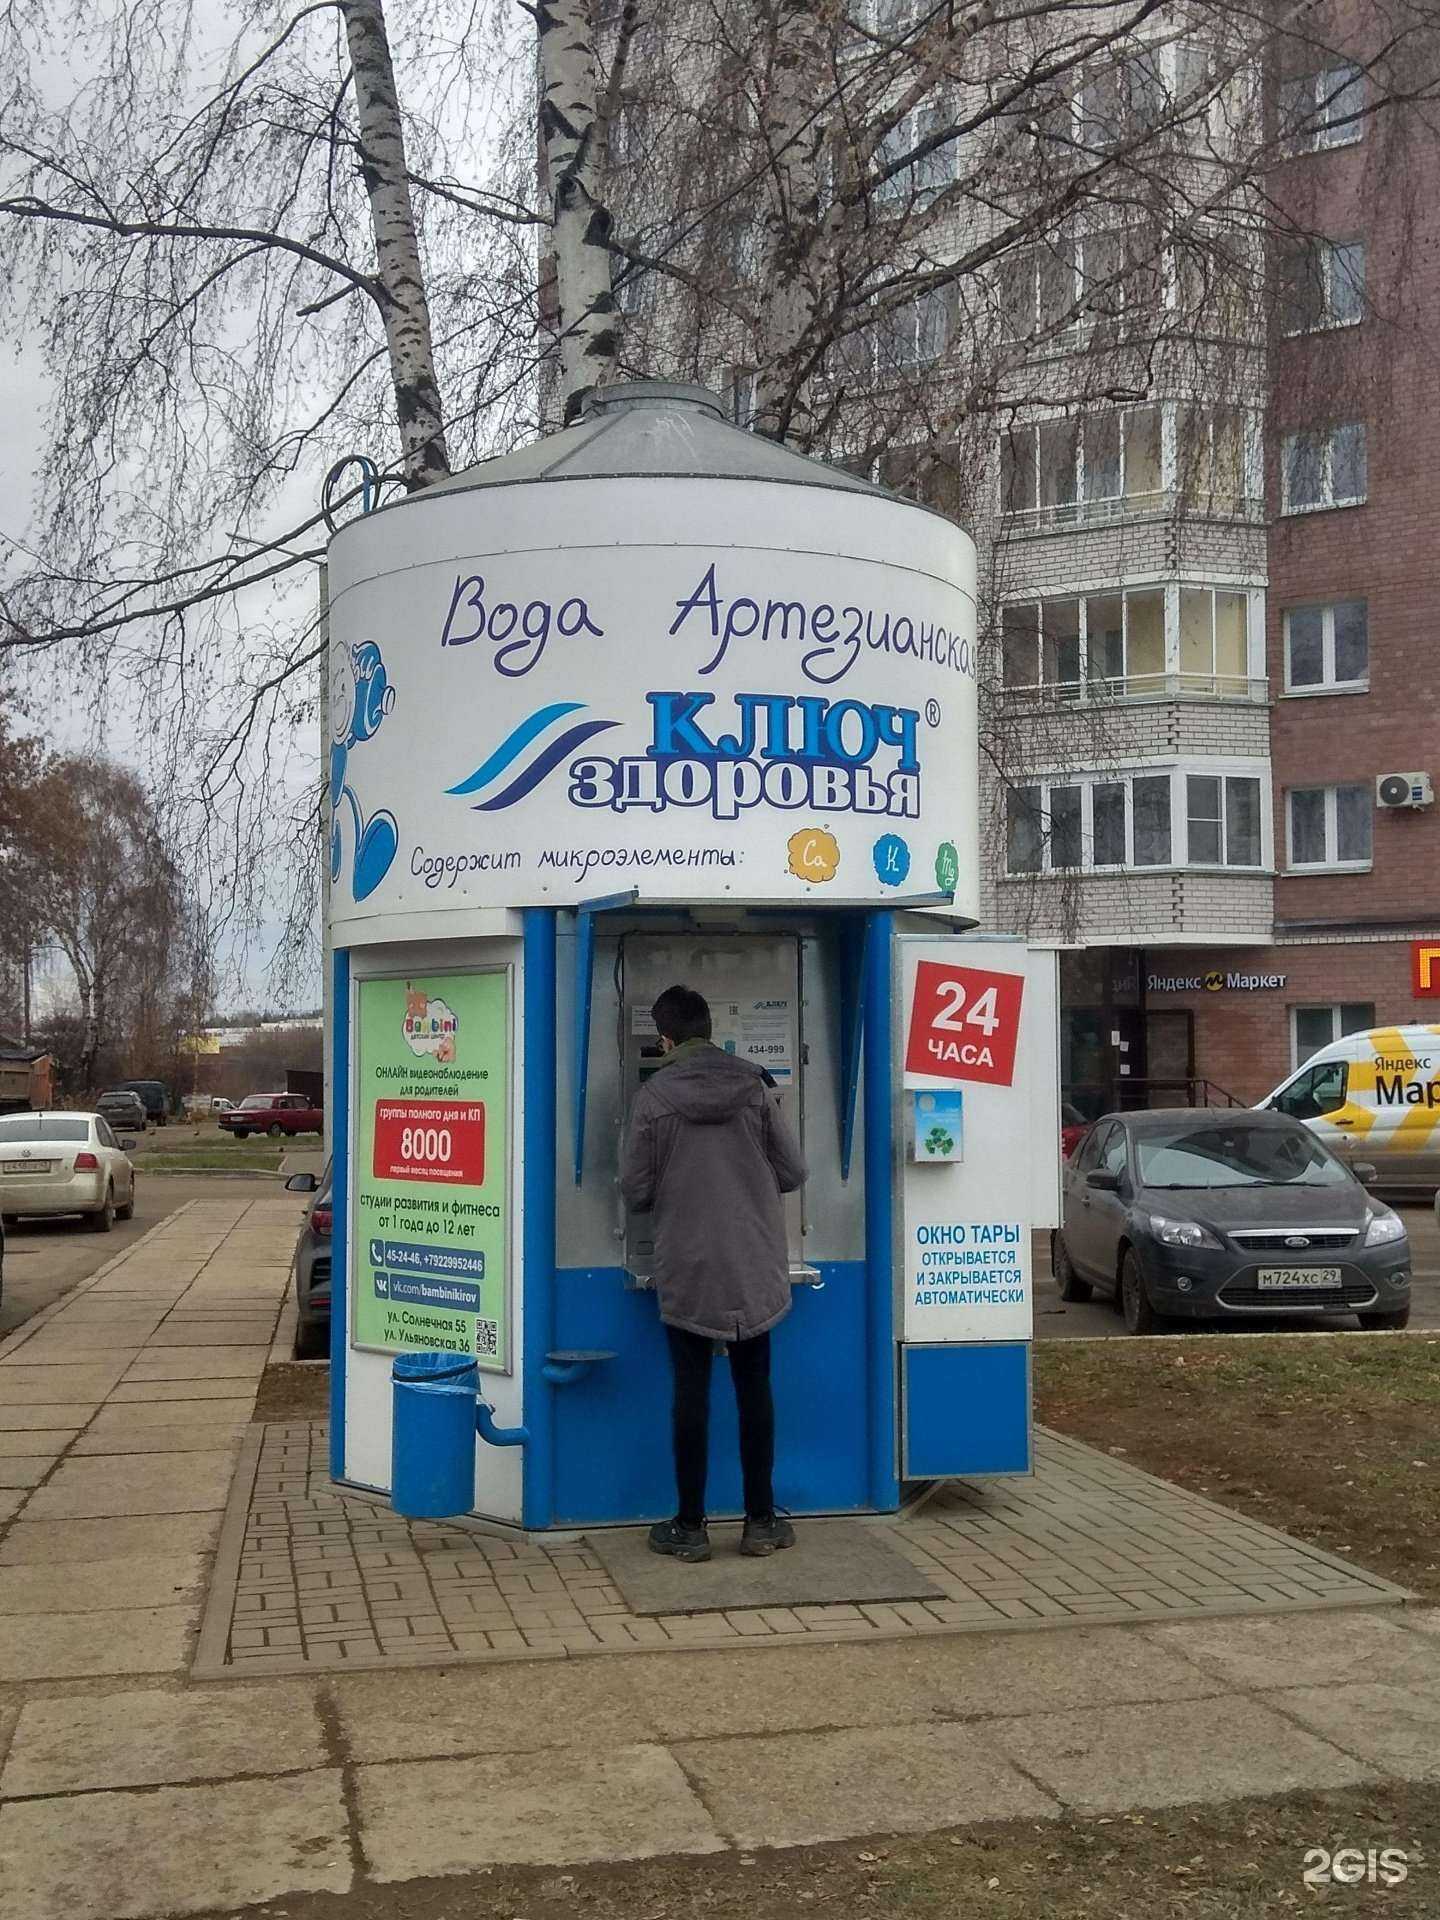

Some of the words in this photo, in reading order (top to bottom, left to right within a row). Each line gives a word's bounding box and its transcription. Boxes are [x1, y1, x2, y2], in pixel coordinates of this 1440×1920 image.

[441, 574, 604, 678] Вода
[568, 756, 921, 819] здоровья
[410, 845, 522, 889] Содержит
[538, 848, 746, 883] микроэлементы:
[1147, 974, 1200, 991] Яндекс
[1227, 972, 1286, 990] Маркет
[931, 980, 1000, 1037] 24
[747, 1045, 785, 1054] 434-999
[928, 1037, 996, 1068] ЧАСА
[376, 1066, 408, 1079] ОНЛАЙН
[409, 1068, 489, 1081] видеонаблюдение
[1375, 1056, 1431, 1072] Яндекс
[400, 1085, 413, 1096] для
[414, 1084, 459, 1096] родителей
[400, 1128, 451, 1162] 8000
[360, 1195, 392, 1209] студии
[394, 1198, 440, 1211] развития
[451, 1200, 500, 1218] фитнеса
[378, 1215, 389, 1227] от
[400, 1218, 424, 1231] года
[426, 1221, 440, 1233] до
[443, 1220, 455, 1234] 12
[457, 1223, 475, 1236] лет
[916, 1225, 966, 1245] ОКНО
[970, 1224, 1020, 1244] ТАРЫ
[921, 1250, 1016, 1266] ОТКРЫВАЕТСЯ
[916, 1272, 926, 1286] И
[928, 1269, 1022, 1286] ЗАКРЫВАЕТСЯ
[393, 1283, 477, 1303] vk.com/bambinikirov
[915, 1289, 1024, 1306] АВТОМАТИЧЕСКИ
[387, 1310, 400, 1324] ул.
[401, 1310, 453, 1331] Солнечная
[455, 1319, 467, 1333] 55
[384, 1328, 397, 1342] ул.
[398, 1328, 457, 1349] Ульяновская
[459, 1337, 470, 1352] 36
